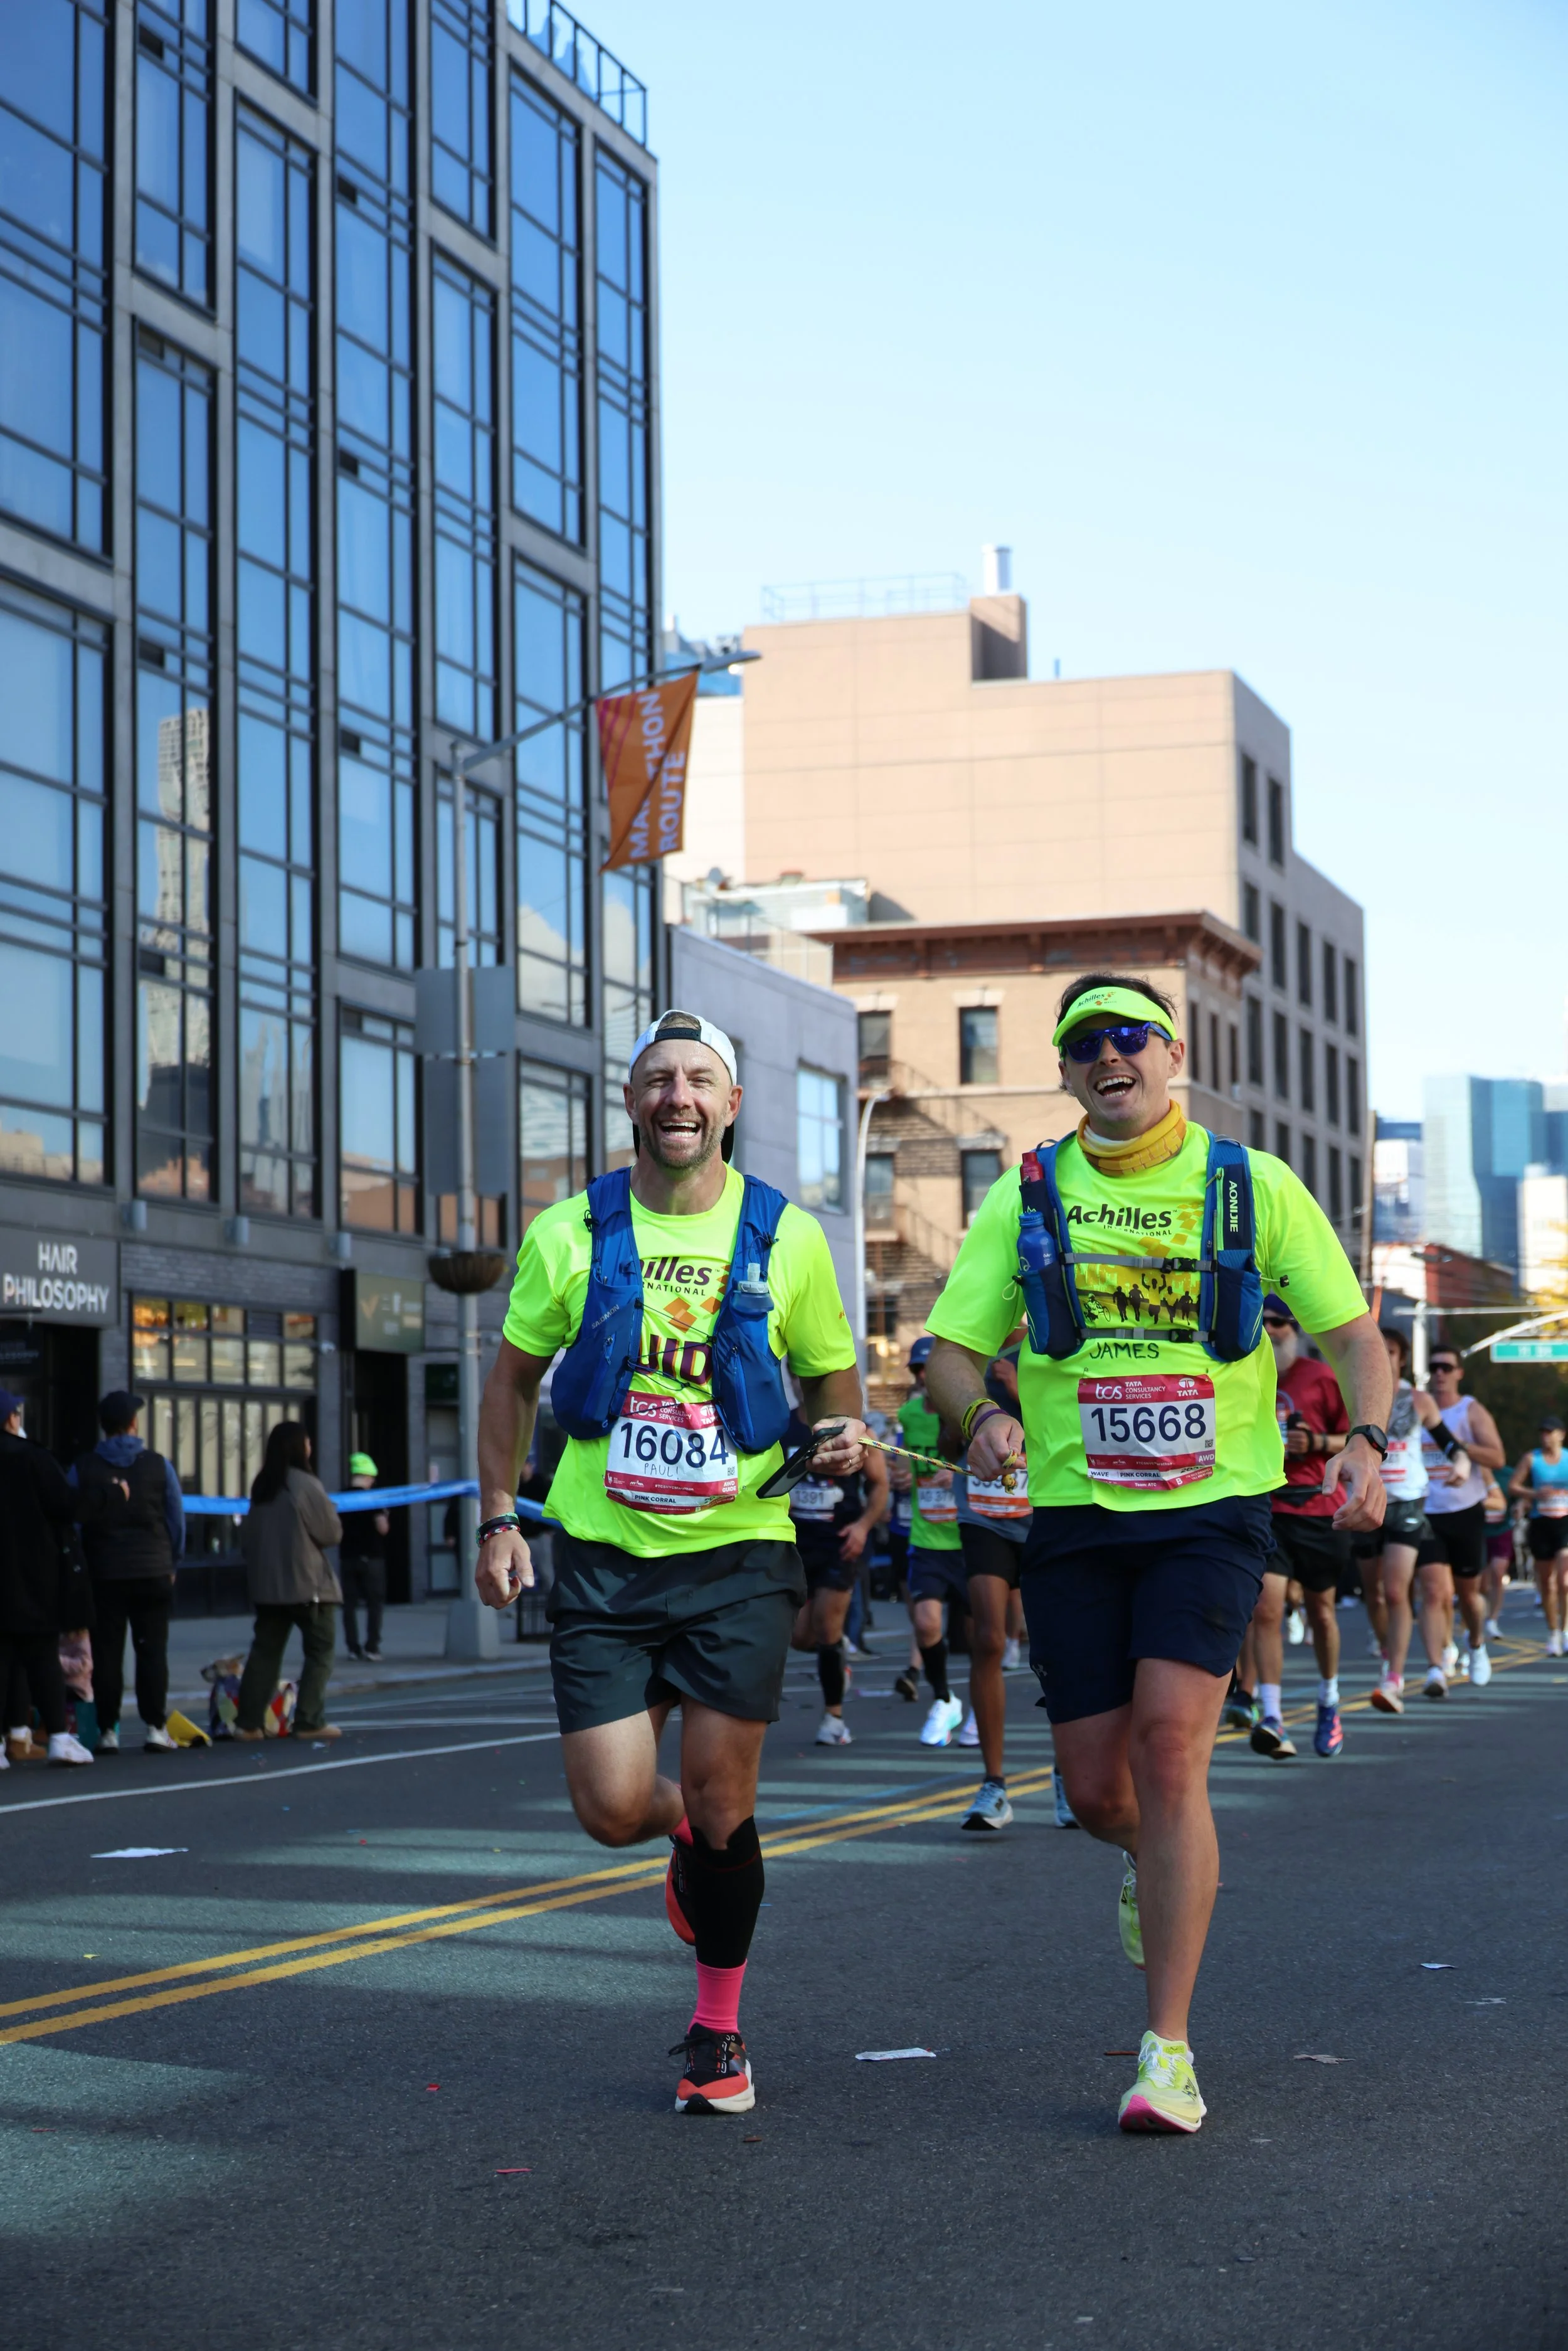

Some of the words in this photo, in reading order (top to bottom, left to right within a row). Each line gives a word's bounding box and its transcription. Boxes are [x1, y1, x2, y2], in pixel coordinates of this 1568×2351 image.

[629, 693, 665, 859] MATHON
[659, 751, 686, 852] ROUTE
[1066, 1204, 1172, 1230] Achilles
[1229, 1180, 1238, 1233] AONIJE
[38, 1241, 78, 1275] HAIR
[3, 1272, 109, 1314] PHILOSOPHY
[1089, 1342, 1159, 1359] JAMES
[630, 1396, 657, 1418] tcs
[1096, 1383, 1122, 1399] tcs
[659, 1413, 684, 1423] SERVICES
[1091, 1403, 1206, 1443] 15668
[620, 1422, 729, 1468] 16084
[1199, 1454, 1215, 1462] AWD
